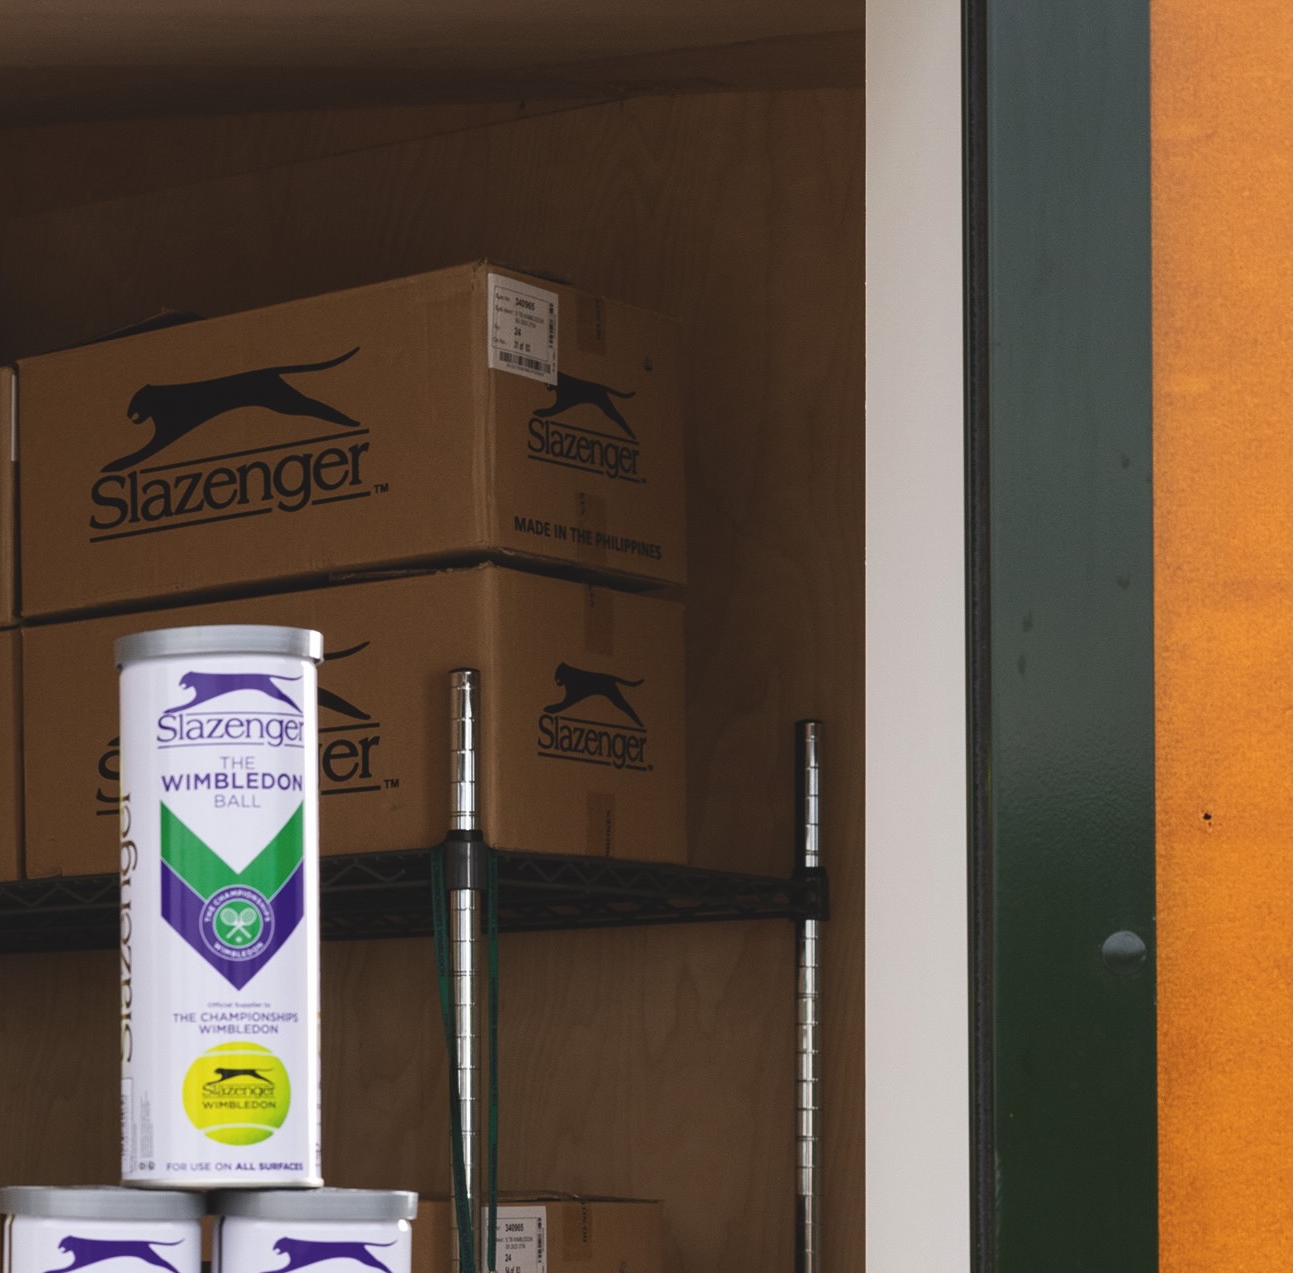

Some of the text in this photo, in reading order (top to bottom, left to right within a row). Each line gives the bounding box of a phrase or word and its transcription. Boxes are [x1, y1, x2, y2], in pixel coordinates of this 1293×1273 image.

[528, 418, 639, 478] Slazenger
[90, 440, 369, 530] Slazenger
[515, 516, 661, 559] MADE IN THE PHILIPPINES
[538, 714, 646, 769] Slazenger
[220, 756, 254, 770] THE
[162, 773, 302, 792] WIMBLEDON
[214, 795, 260, 808] BALL
[174, 1012, 298, 1023] THE CHAMPIONSHIPS
[199, 1025, 278, 1034] WIMBLEDON
